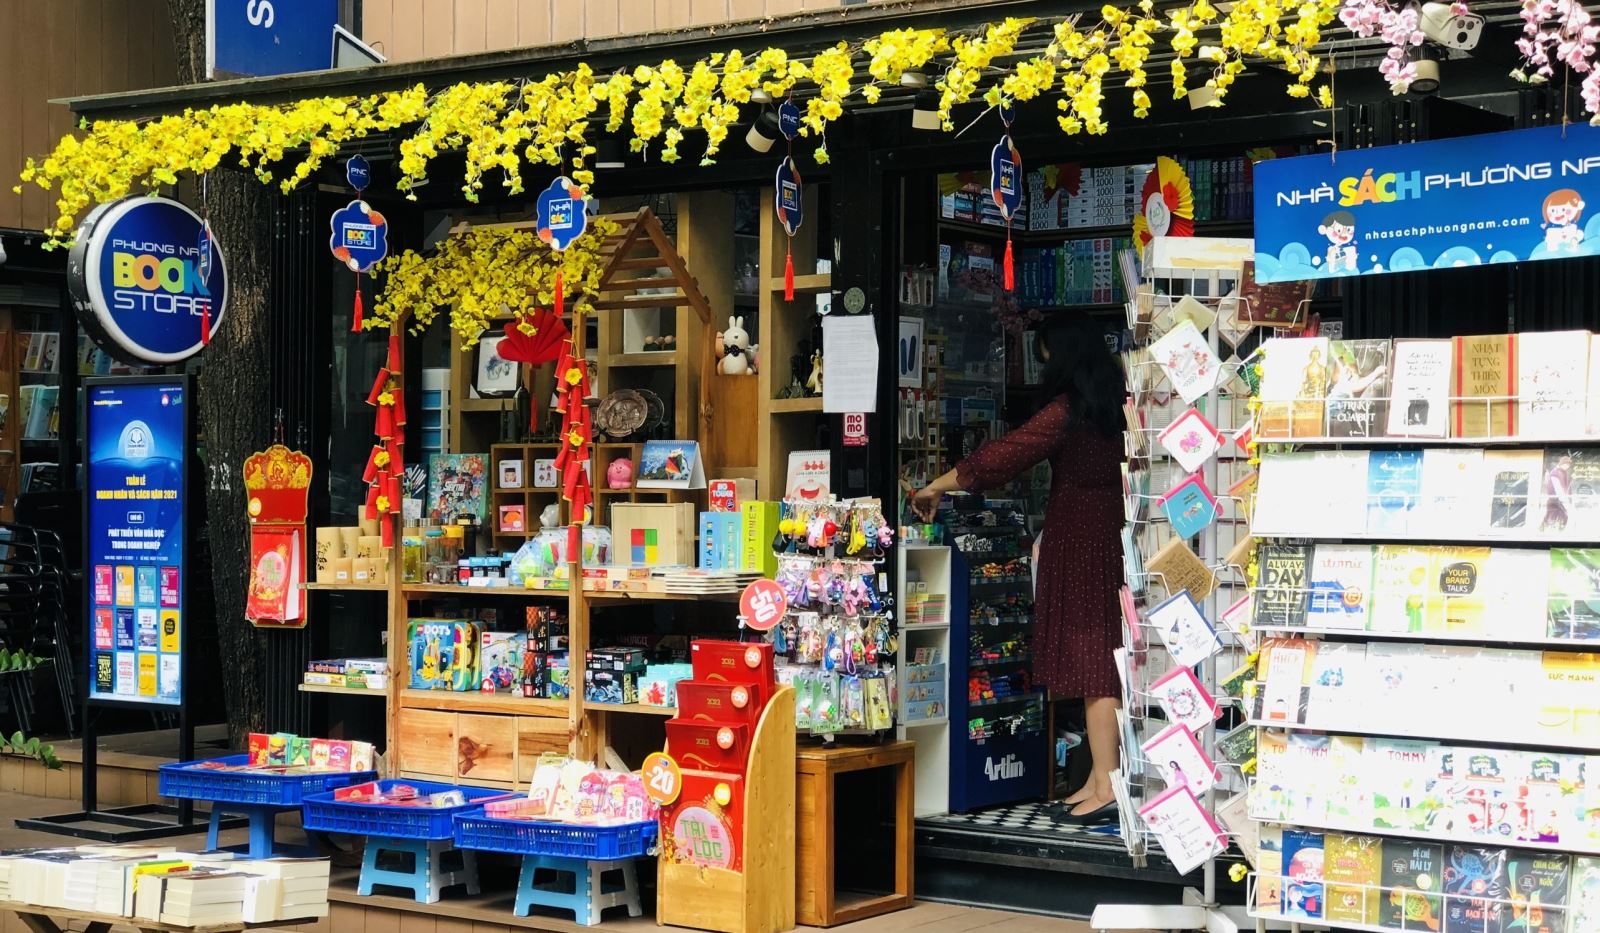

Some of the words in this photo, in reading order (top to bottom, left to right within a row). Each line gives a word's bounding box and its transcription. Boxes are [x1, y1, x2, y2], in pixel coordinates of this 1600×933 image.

[782, 114, 798, 124] PNC
[350, 168, 368, 176] PNC
[1096, 178, 1114, 186] 1000
[1277, 182, 1334, 207] NHÀ
[1338, 168, 1421, 207] SÁCH
[1424, 161, 1552, 191] PHƯƠNG
[1561, 156, 1600, 176] NA
[1096, 188, 1114, 196] 1000
[550, 202, 570, 212] NHÀ
[550, 212, 570, 224] SÁCH
[1032, 212, 1048, 220] 1000
[1032, 221, 1048, 230] 1000
[1365, 216, 1530, 241] nhasachphuongnam.com
[347, 230, 372, 240] BOOK
[112, 239, 174, 254] PHUONG
[180, 246, 200, 257] NA
[113, 252, 212, 296] BOOK
[114, 290, 212, 316] STORE
[136, 489, 150, 500] SÁCH
[164, 490, 177, 500] 2021
[108, 528, 120, 537] PHÁT
[112, 540, 126, 549] TRONG
[1268, 560, 1305, 569] ALWAYS
[1266, 568, 1304, 585] DAY
[1446, 577, 1470, 585] BRAND
[1262, 584, 1307, 602] ONE
[1447, 585, 1468, 593] TALKS
[750, 586, 778, 622] -50
[424, 624, 450, 636] DOTS
[1300, 746, 1328, 757] TOMM
[1388, 750, 1426, 763] TOMMY
[646, 765, 675, 795] -20
[680, 816, 705, 838] TÀI
[693, 840, 722, 864] LỘC
